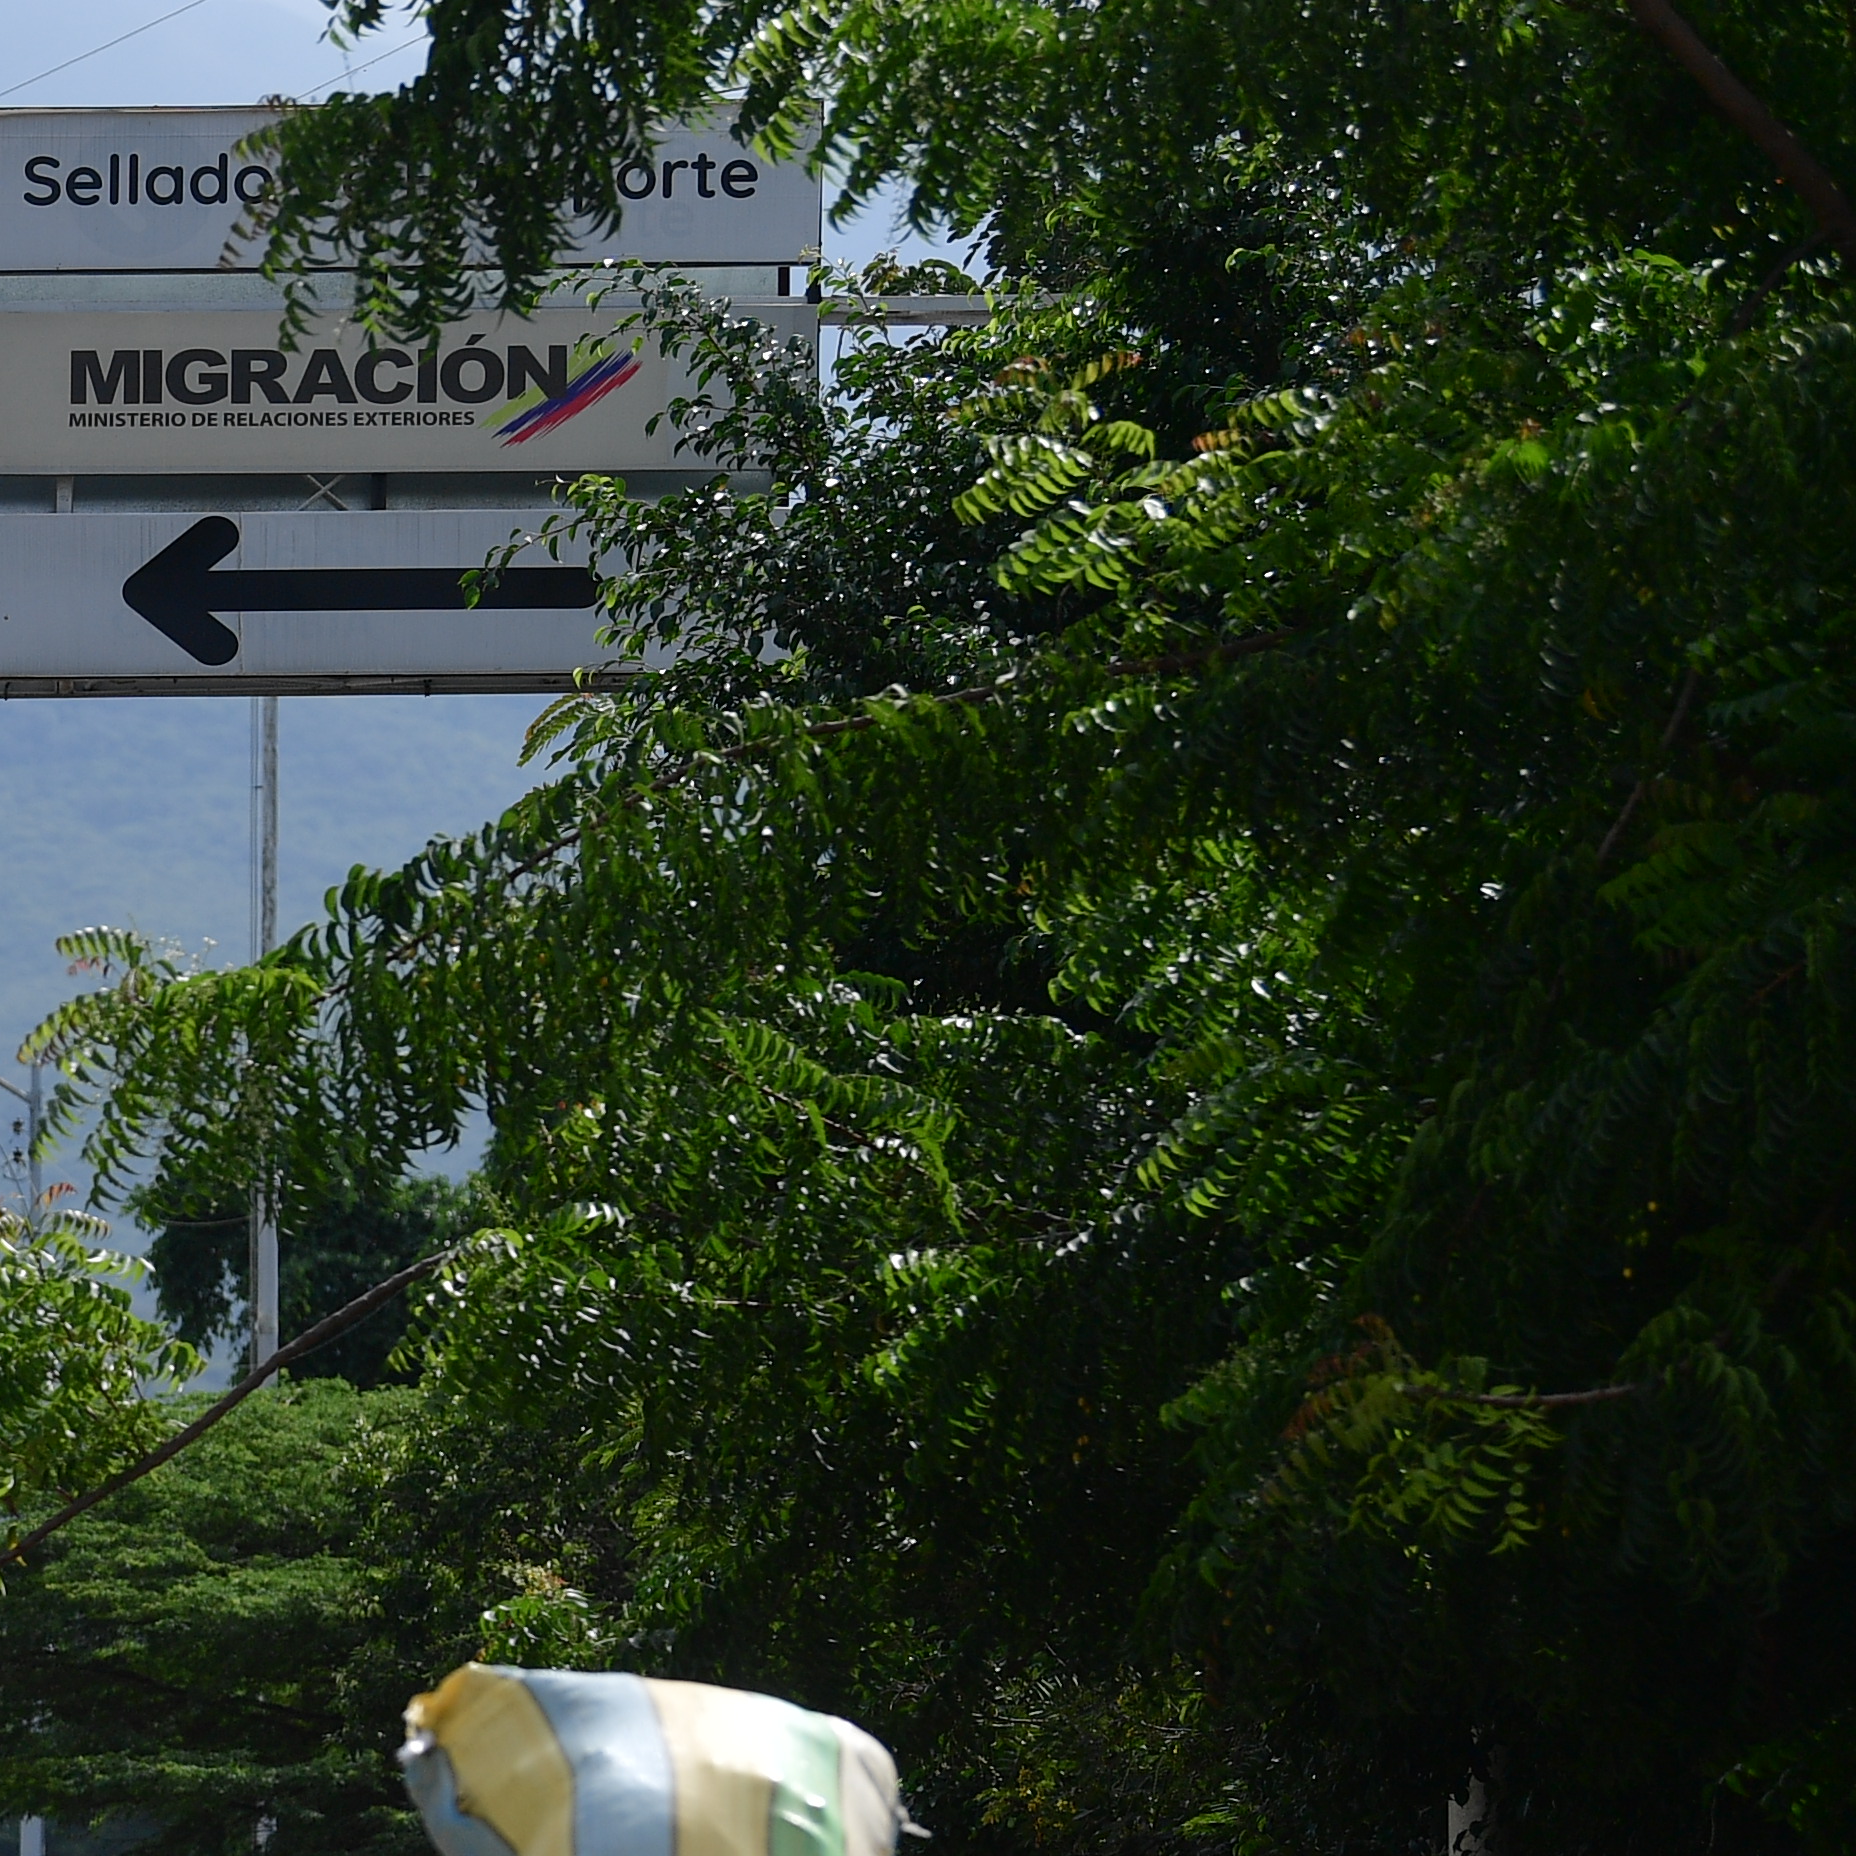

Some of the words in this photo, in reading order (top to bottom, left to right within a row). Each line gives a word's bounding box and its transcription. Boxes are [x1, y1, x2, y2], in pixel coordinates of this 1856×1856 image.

[22, 152, 272, 206] Sellado
[69, 334, 568, 406] MIGRACIÓN
[68, 412, 186, 428] MINISTERIO
[190, 412, 218, 428] DE
[223, 411, 348, 428] RELACIONES
[353, 411, 475, 428] EXTERIORES
